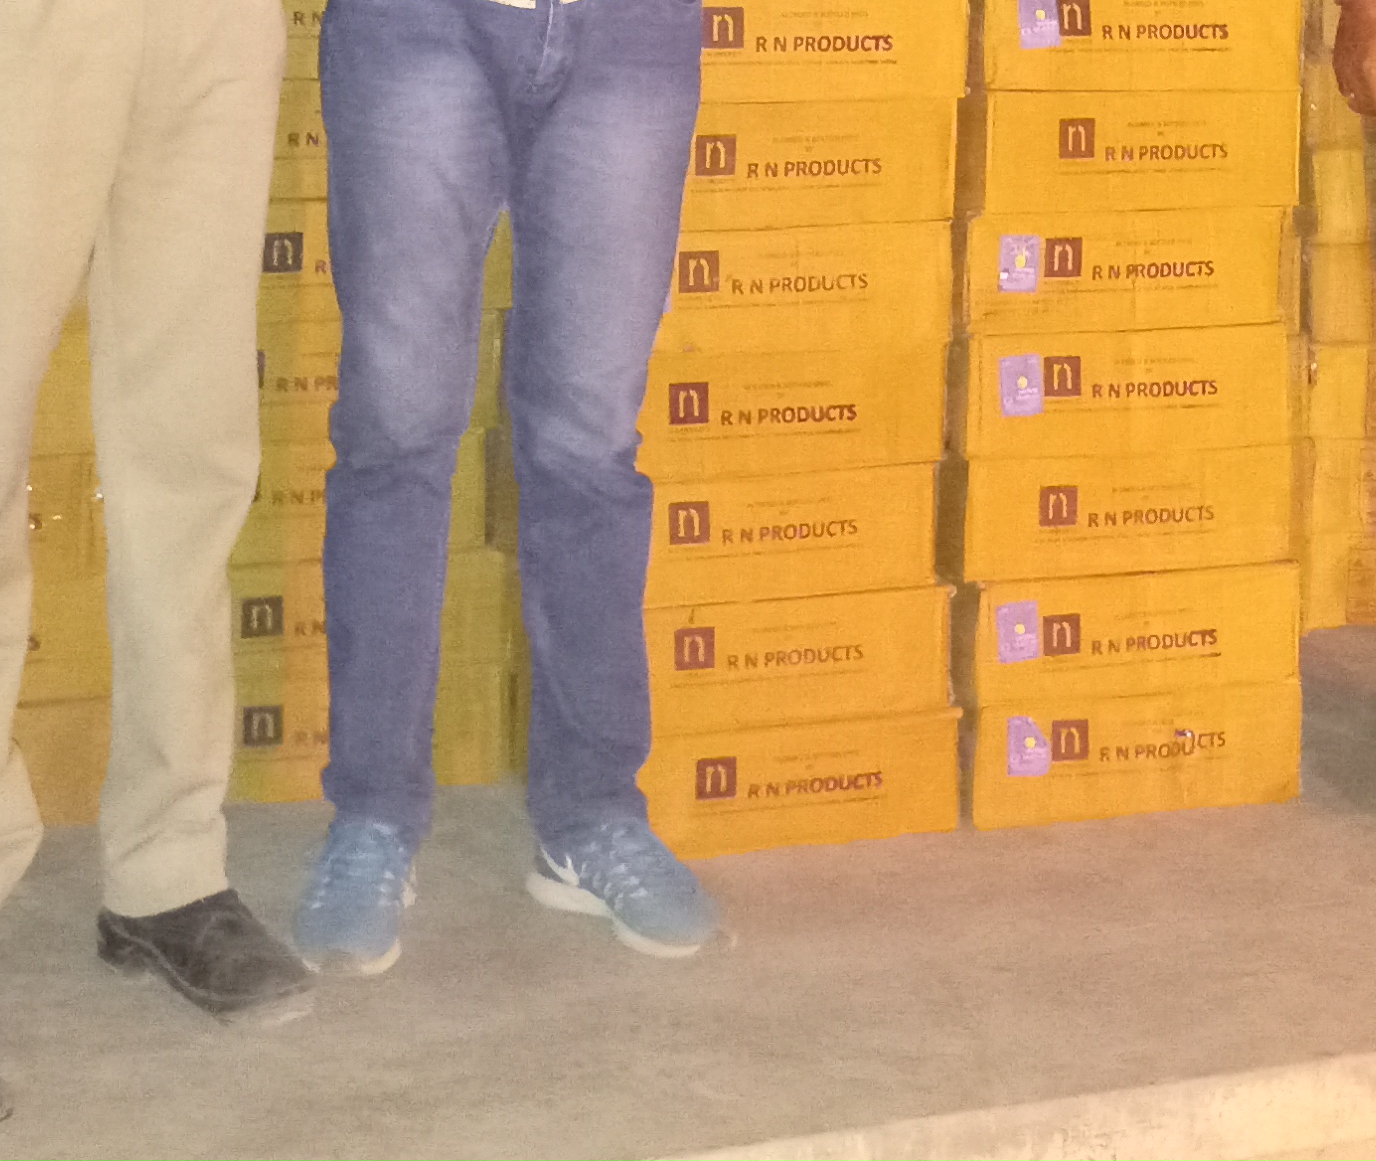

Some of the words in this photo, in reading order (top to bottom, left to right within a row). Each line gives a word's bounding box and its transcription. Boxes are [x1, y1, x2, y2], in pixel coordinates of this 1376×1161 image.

[1102, 25, 1113, 39] R
[1119, 24, 1131, 40] N
[1136, 23, 1229, 40] PRODUCTS
[756, 36, 767, 52] R
[774, 37, 787, 52] N
[794, 34, 893, 52] PRODUCTS
[1105, 146, 1115, 161] R
[1121, 146, 1134, 161] N
[1139, 144, 1228, 160] PRODUCTS
[747, 163, 758, 178] R
[765, 162, 778, 177] N
[784, 158, 882, 177] PRODUCTS
[1092, 265, 1103, 280] R
[1108, 265, 1120, 279] N
[1126, 260, 1214, 279] PRODUCTS
[732, 279, 744, 295] R
[750, 279, 763, 294] N
[769, 274, 868, 294] PRODUCTS
[1092, 384, 1102, 398] R
[1108, 383, 1120, 398] N
[1126, 380, 1218, 397] PRODUCTS
[721, 410, 733, 426] R
[739, 410, 752, 425] N
[758, 404, 857, 424] PRODUCTS
[1088, 513, 1098, 527] R
[1105, 512, 1117, 526] N
[1122, 505, 1215, 525] PRODUCTS
[722, 529, 734, 545] R
[740, 529, 754, 543] N
[759, 519, 857, 542] PRODUCTS
[1091, 640, 1103, 655] R
[1108, 639, 1120, 653] N
[1126, 628, 1217, 653] PRODUCTS
[728, 655, 739, 669] R
[745, 653, 758, 668] N
[764, 644, 864, 668] PRODUCTS
[1099, 747, 1111, 762] R
[1116, 746, 1129, 761] N
[1134, 731, 1226, 759] PRODUCTS
[748, 784, 760, 799] R
[766, 782, 779, 797] N
[785, 770, 883, 796] PRODUCTS
